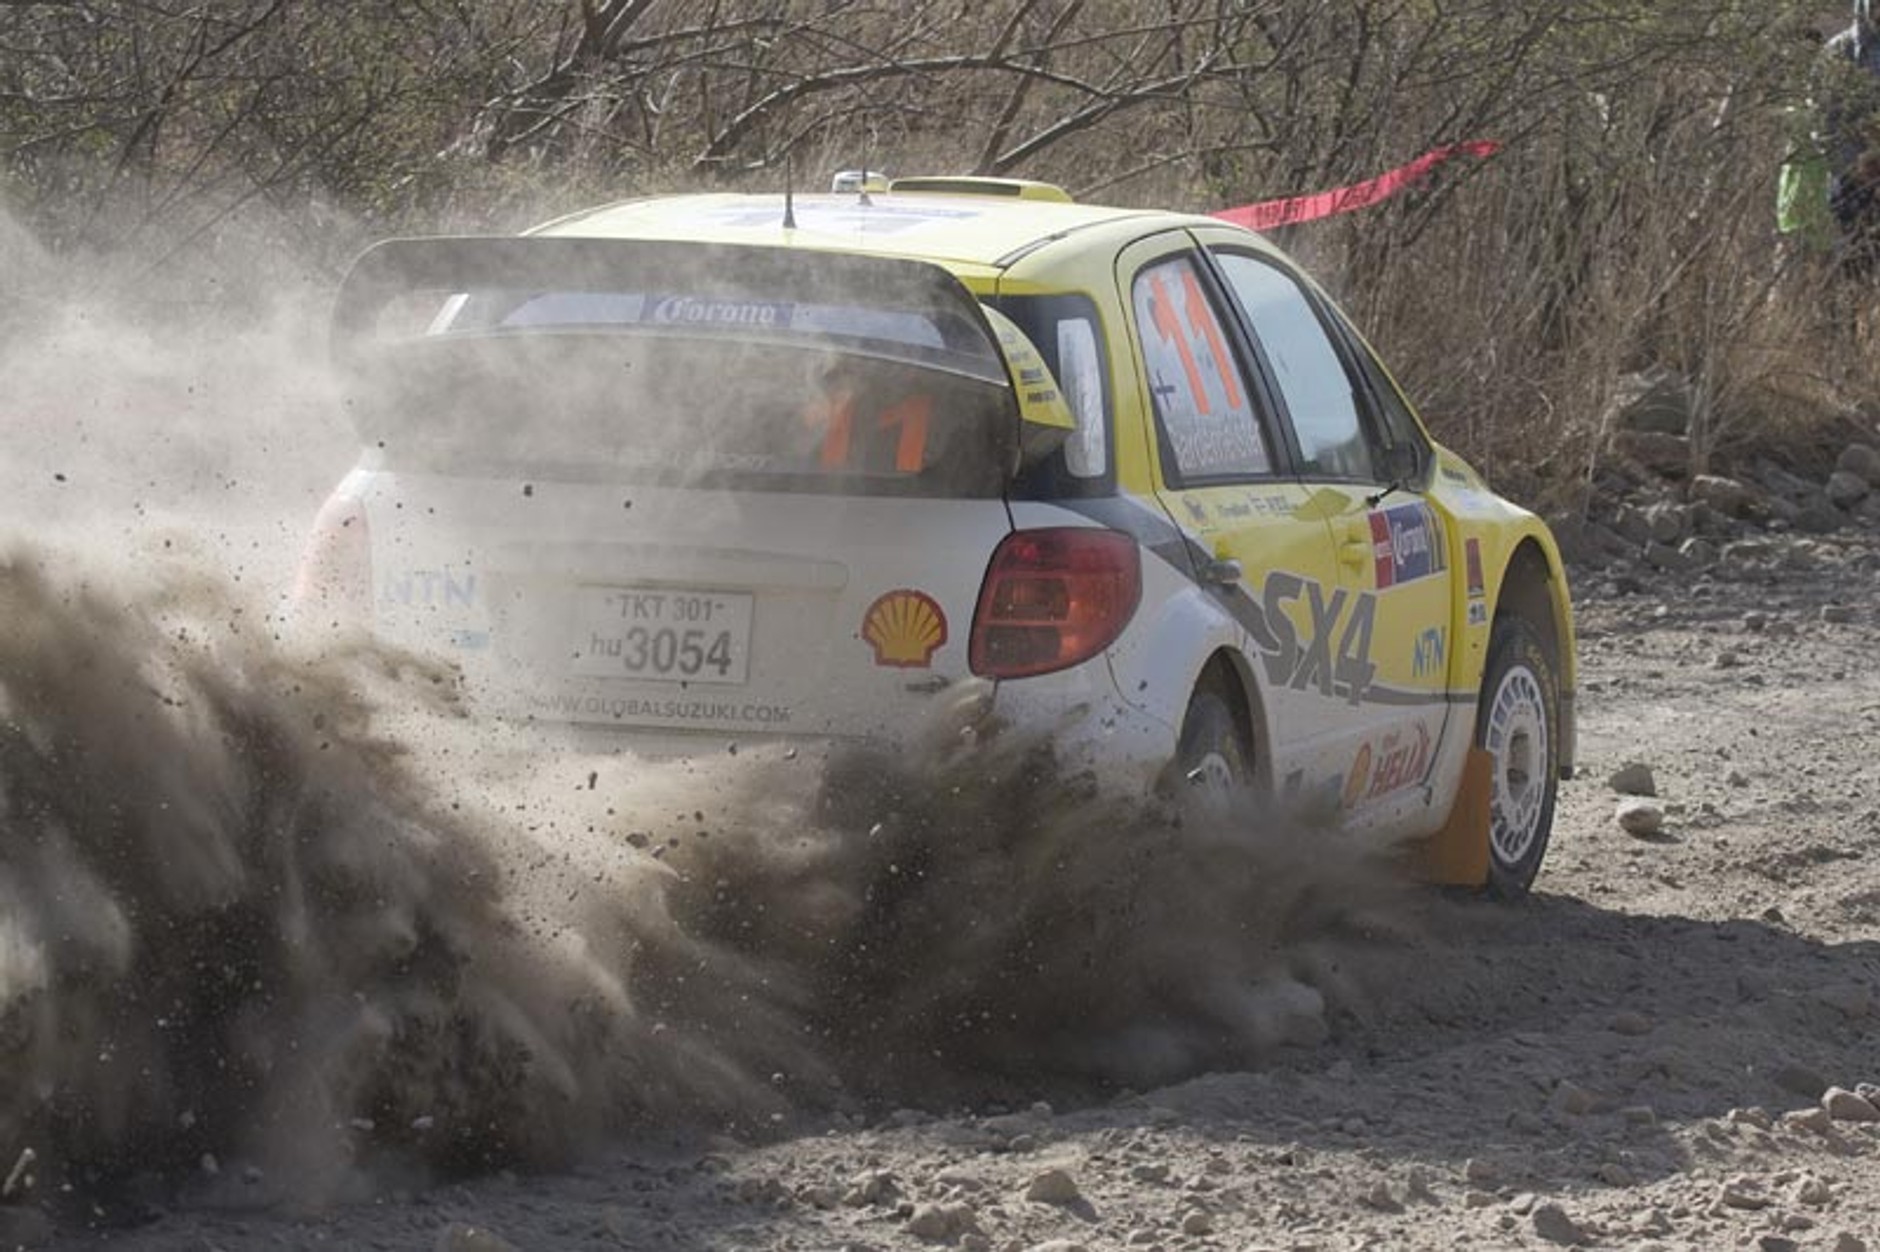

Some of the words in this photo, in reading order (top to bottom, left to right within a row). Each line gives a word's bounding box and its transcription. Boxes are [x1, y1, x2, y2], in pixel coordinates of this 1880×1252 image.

[1150, 270, 1242, 416] 11
[804, 391, 931, 473] 11
[617, 593, 667, 619] TKT
[673, 597, 713, 622] 301
[1261, 569, 1379, 707] SX4
[623, 625, 732, 676] 3054
[1412, 624, 1446, 678] NTN
